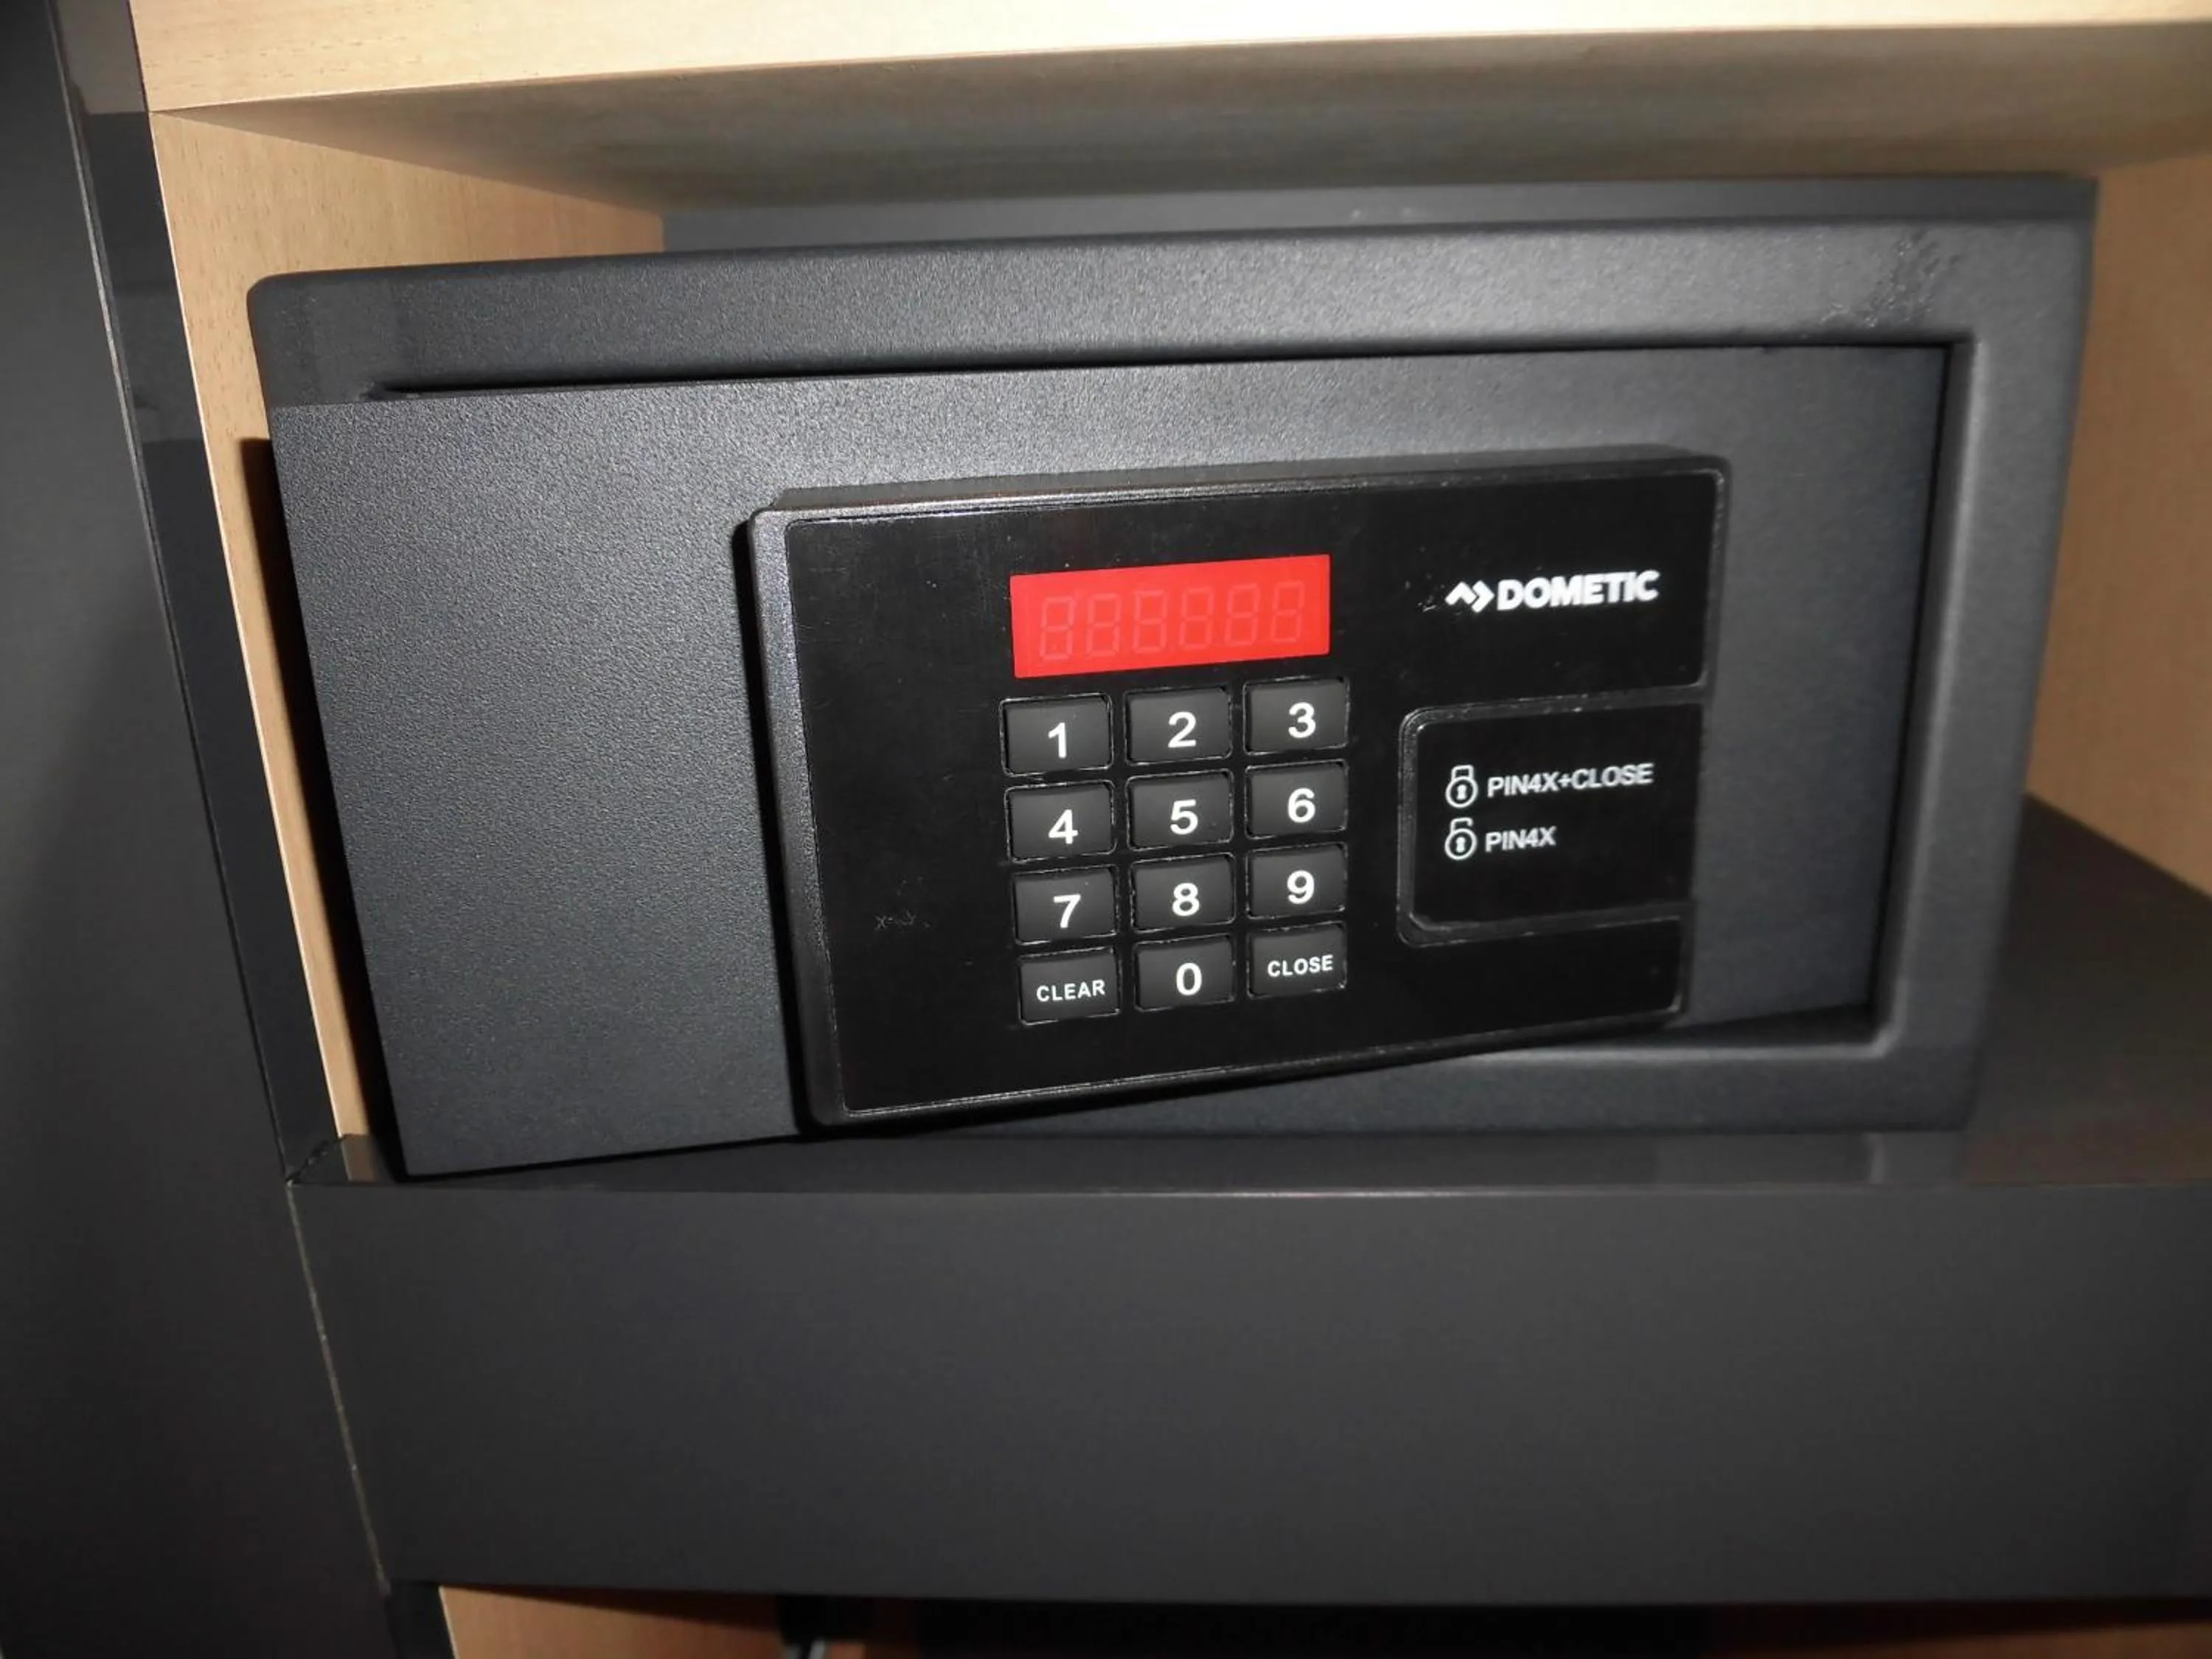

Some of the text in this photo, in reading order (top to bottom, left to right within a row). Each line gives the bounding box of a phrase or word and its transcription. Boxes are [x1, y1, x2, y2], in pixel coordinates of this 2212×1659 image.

[1496, 570, 1660, 611] DOMETIC
[1047, 701, 1317, 759] 1 2 3
[1487, 762, 1655, 798] PIN4X+CLOSE
[1048, 787, 1316, 845] 4 5 6
[1485, 826, 1557, 852] PIN4X
[1052, 869, 1315, 929] 7 8 9
[1036, 953, 1335, 1004] CLEAR 0 CLOSE
